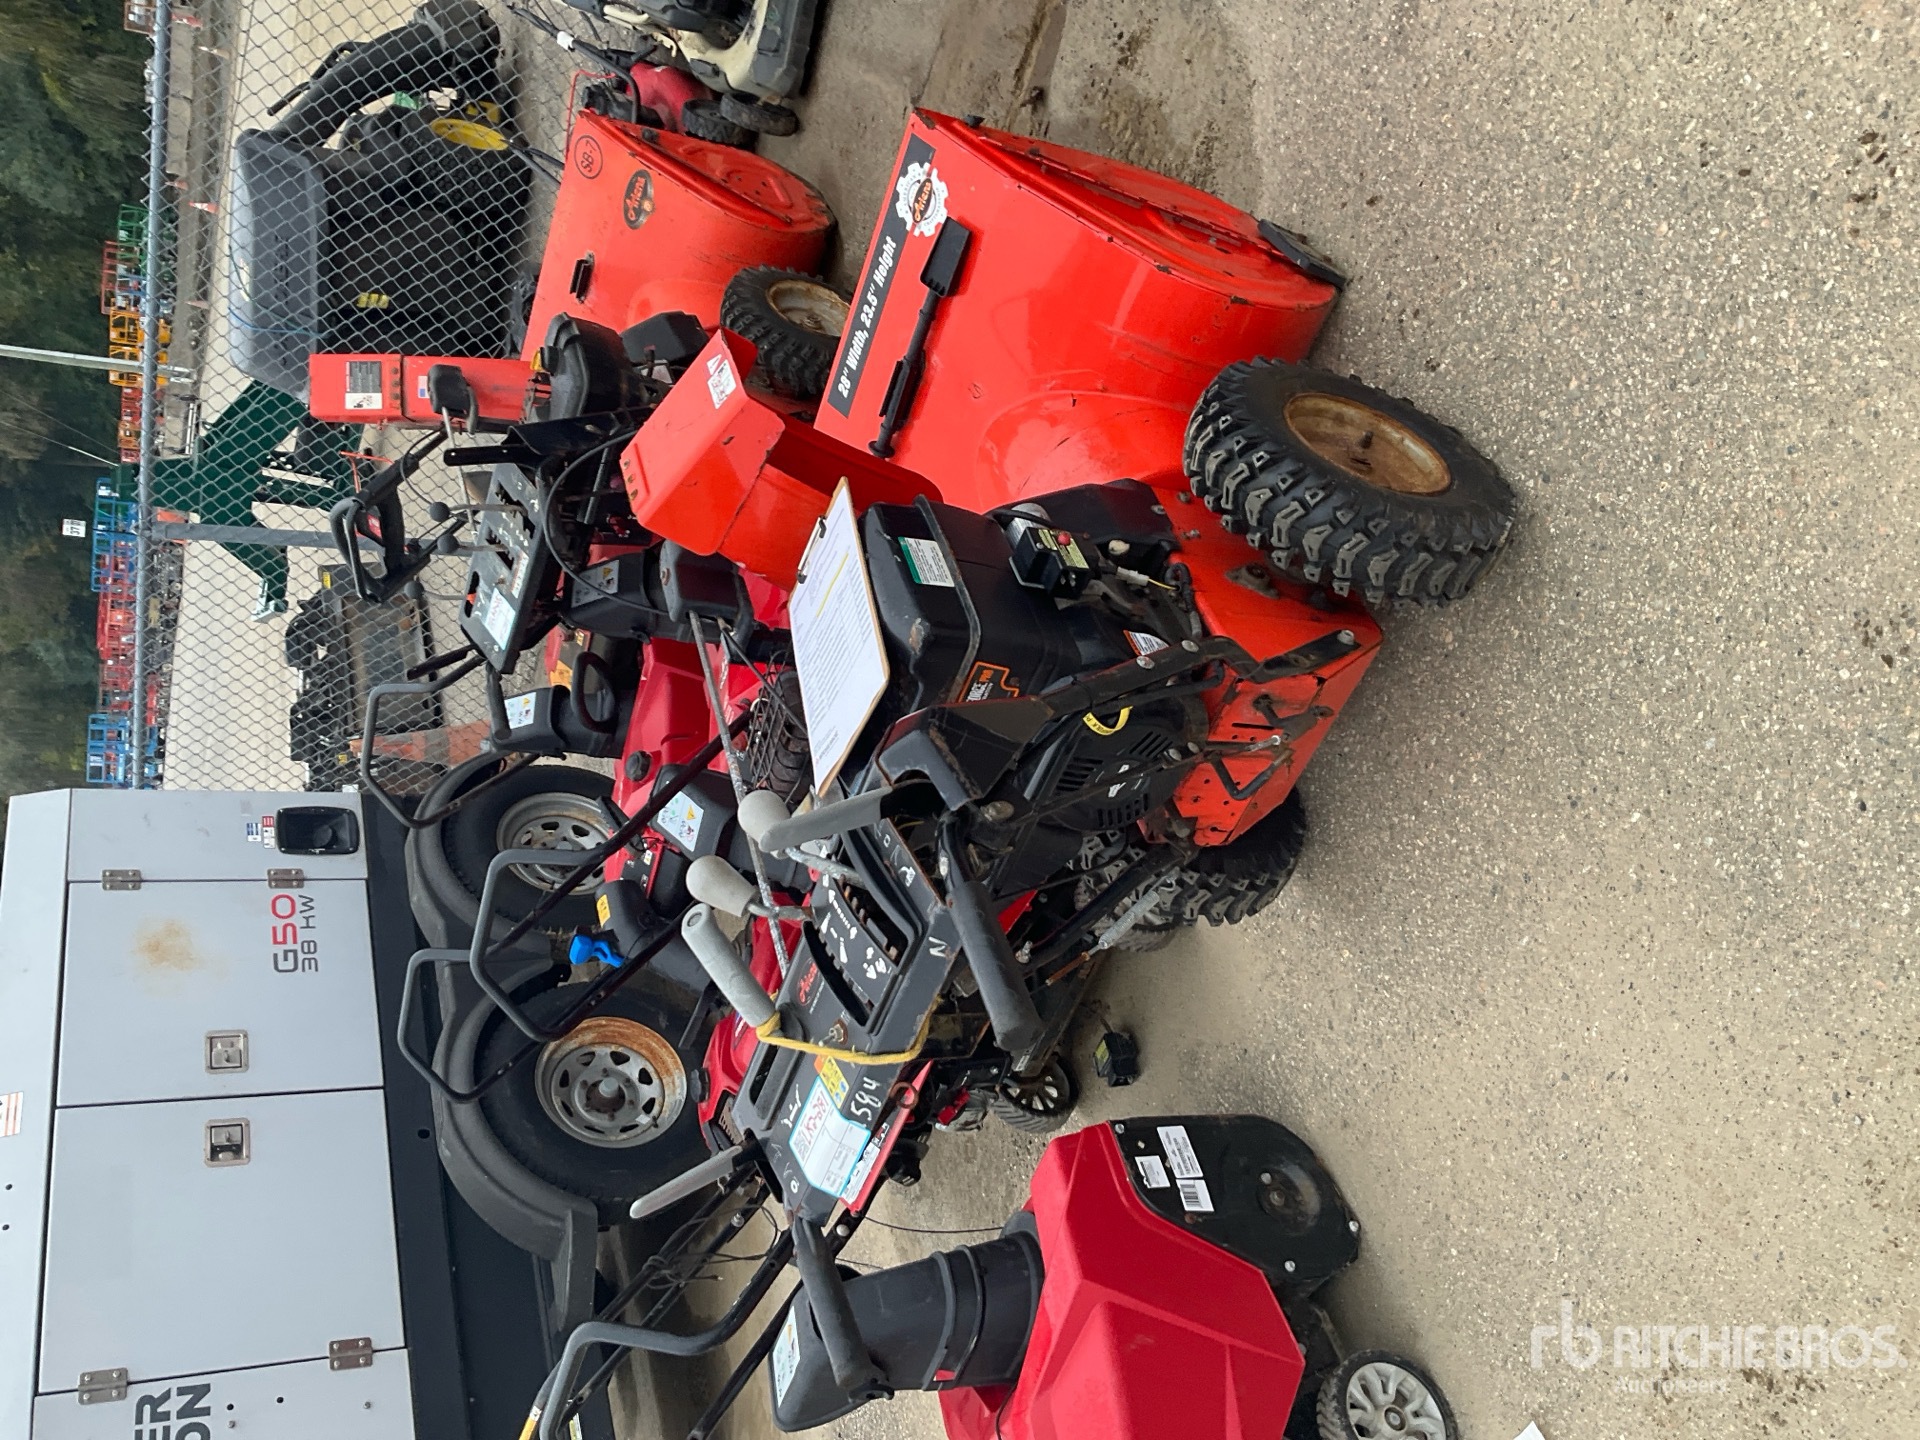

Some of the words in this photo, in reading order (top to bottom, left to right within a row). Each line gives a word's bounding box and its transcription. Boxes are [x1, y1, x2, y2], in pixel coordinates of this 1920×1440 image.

[625, 176, 646, 221] Ariens
[914, 181, 932, 222] Ariens
[846, 329, 869, 371] Width,
[873, 236, 897, 288] Height
[271, 894, 298, 973] G50
[301, 940, 318, 972] 38
[850, 1077, 882, 1121] 584
